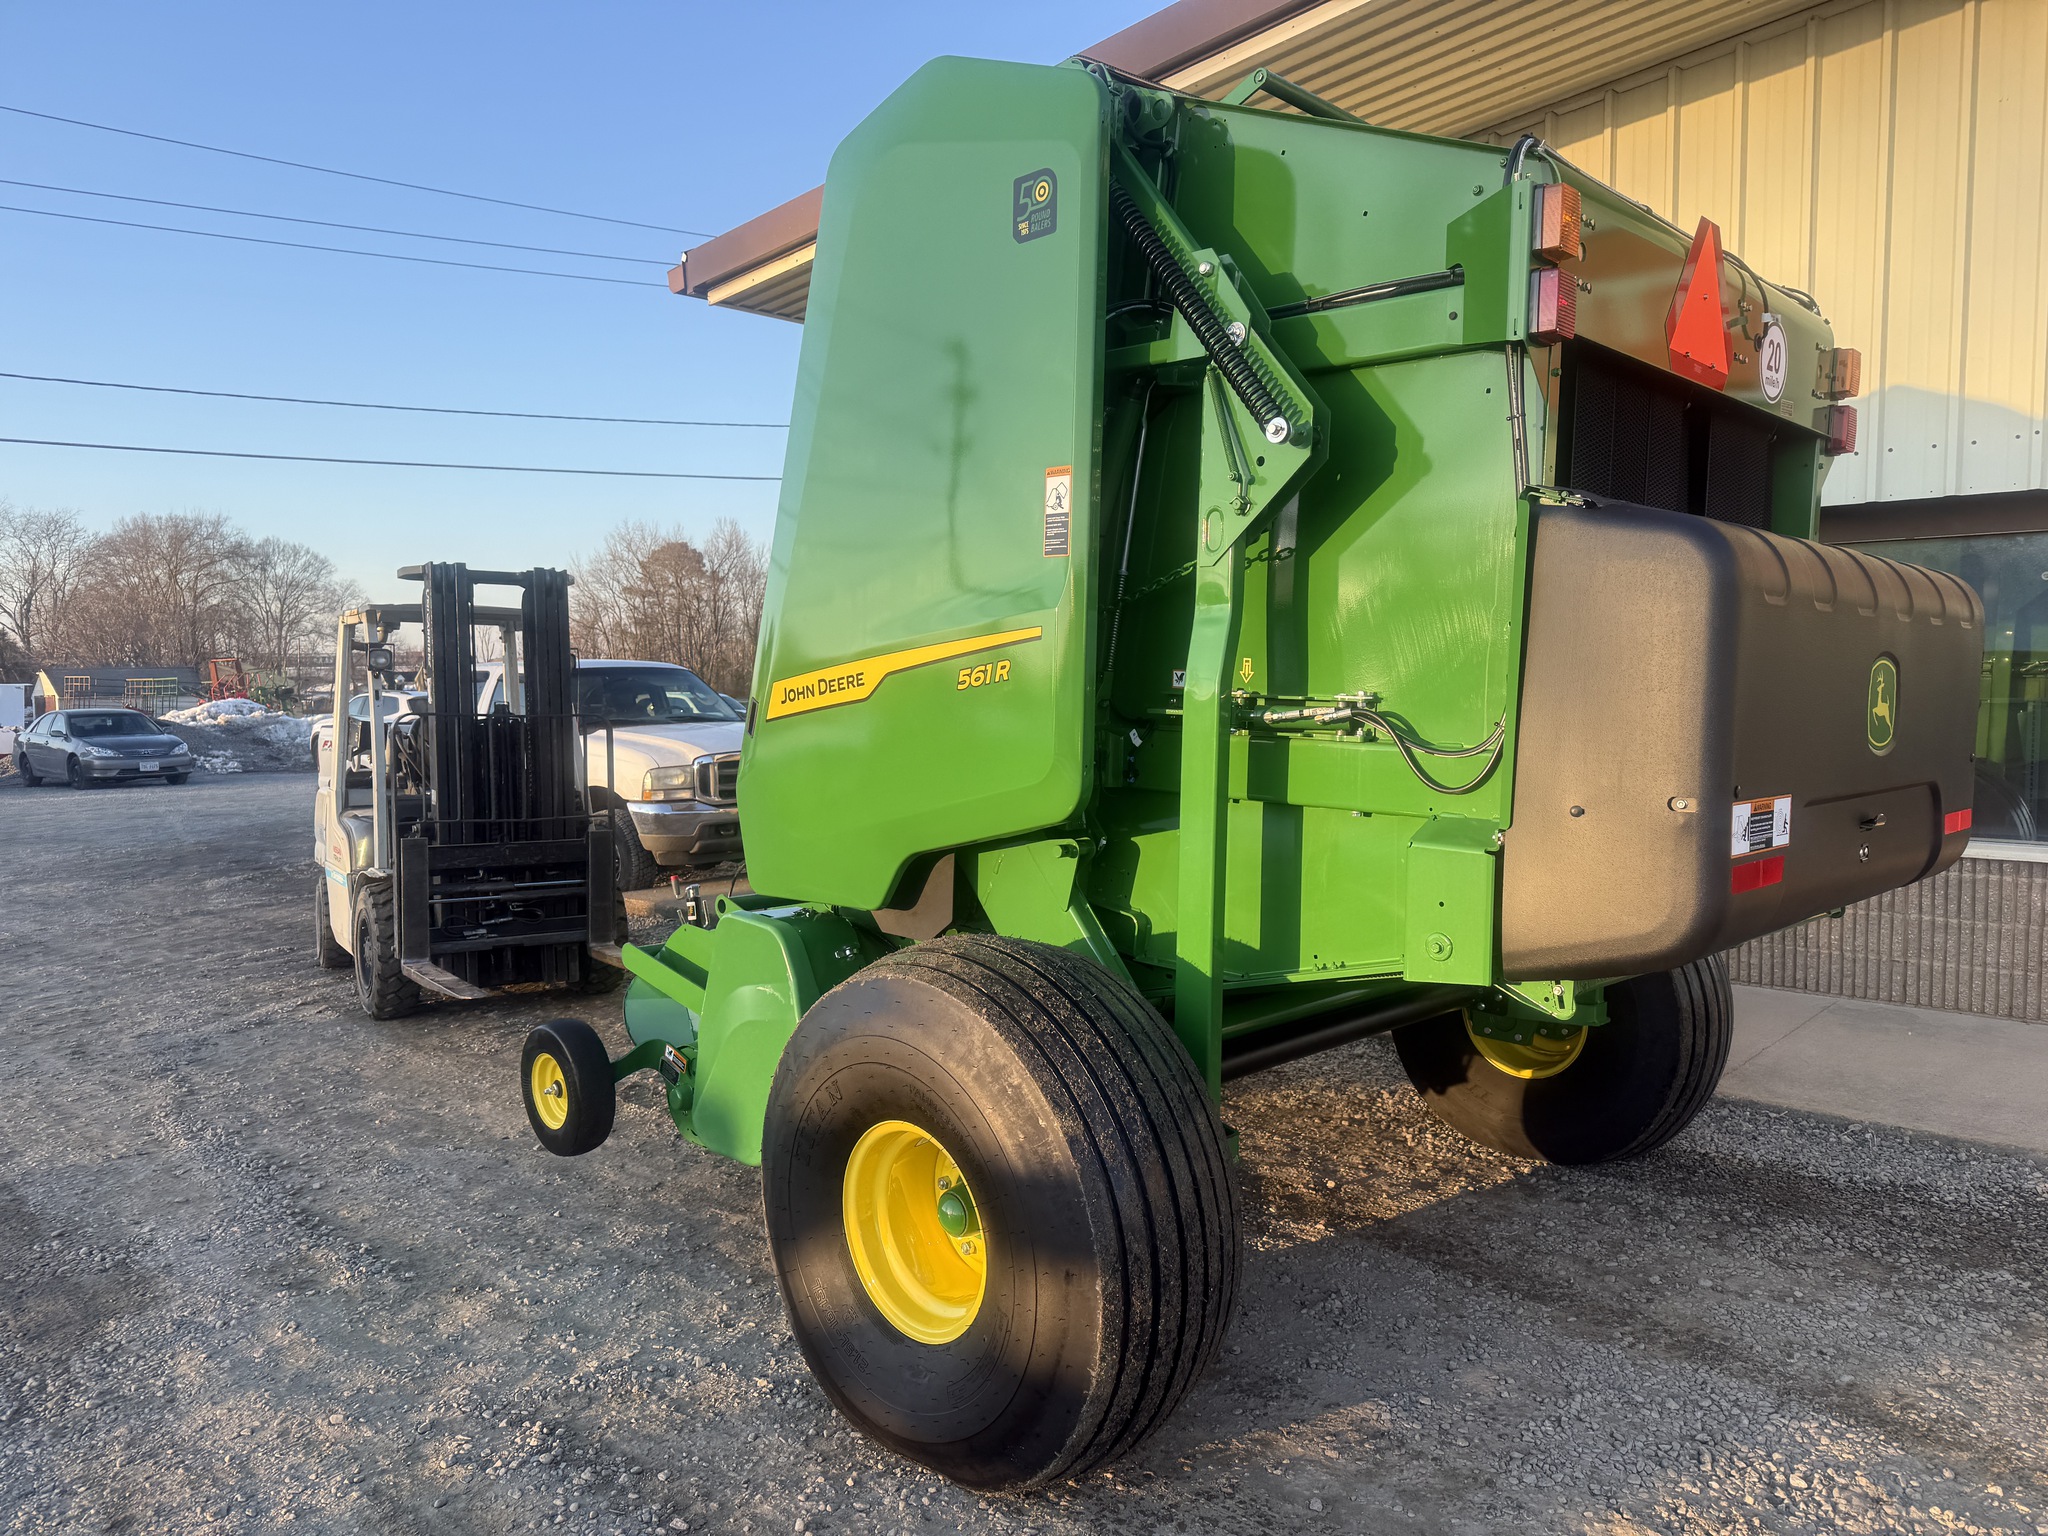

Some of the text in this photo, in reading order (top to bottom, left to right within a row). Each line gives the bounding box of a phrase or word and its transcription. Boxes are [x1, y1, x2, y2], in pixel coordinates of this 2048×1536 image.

[1017, 175, 1053, 221] 50
[1766, 339, 1781, 375] 20
[781, 672, 865, 704] JOHN DEERE
